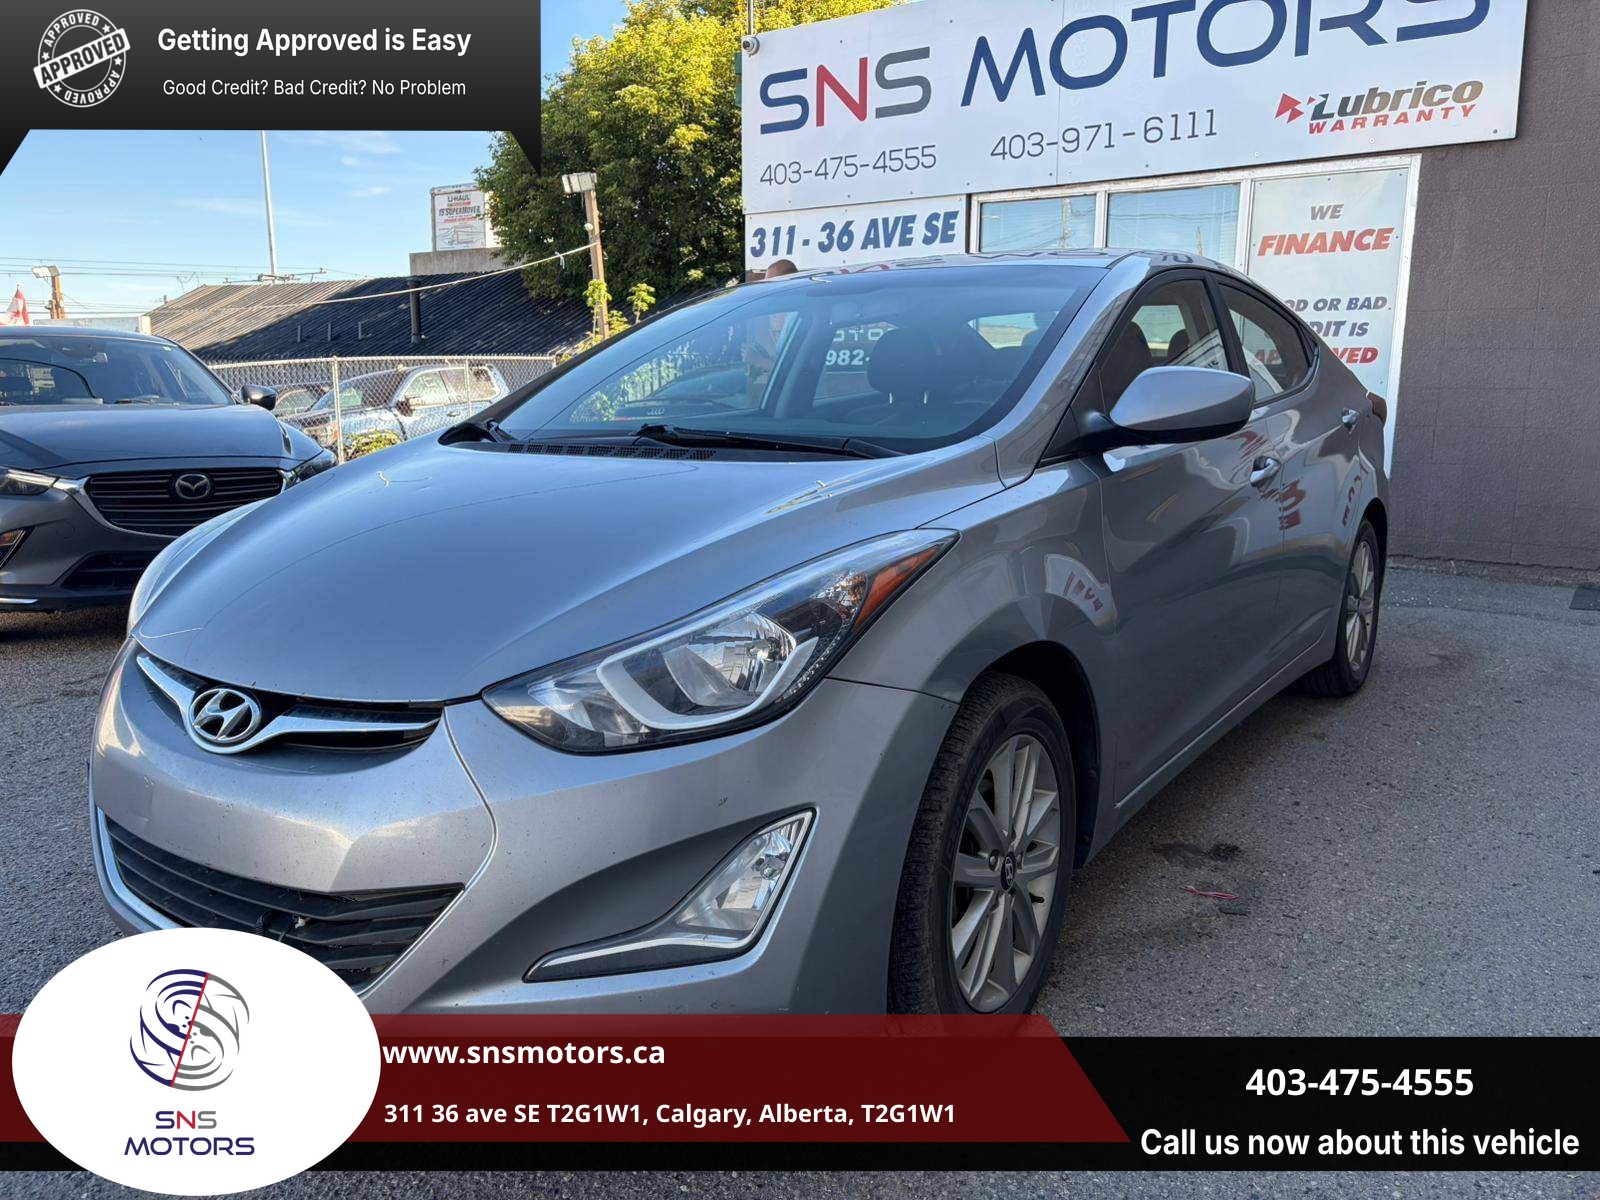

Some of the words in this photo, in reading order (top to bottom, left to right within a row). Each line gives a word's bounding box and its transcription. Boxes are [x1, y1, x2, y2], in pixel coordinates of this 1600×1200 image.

[760, 46, 931, 135] SNS
[961, 0, 1490, 107] MOTORS
[1310, 80, 1484, 122] Lubrico
[990, 108, 1218, 161] 403-971-6111
[1308, 104, 1477, 135] WARRANTY
[760, 144, 937, 186] 403-475-4555
[1310, 204, 1344, 221] WE
[750, 225, 797, 257] 311
[817, 220, 855, 254] 36
[861, 214, 917, 250] AVE
[920, 210, 960, 246] SE
[1257, 227, 1395, 257] FINANCE
[1285, 299, 1308, 312] OD
[1313, 298, 1341, 312] OR
[1309, 320, 1347, 338] DIT
[1349, 321, 1370, 338] IS
